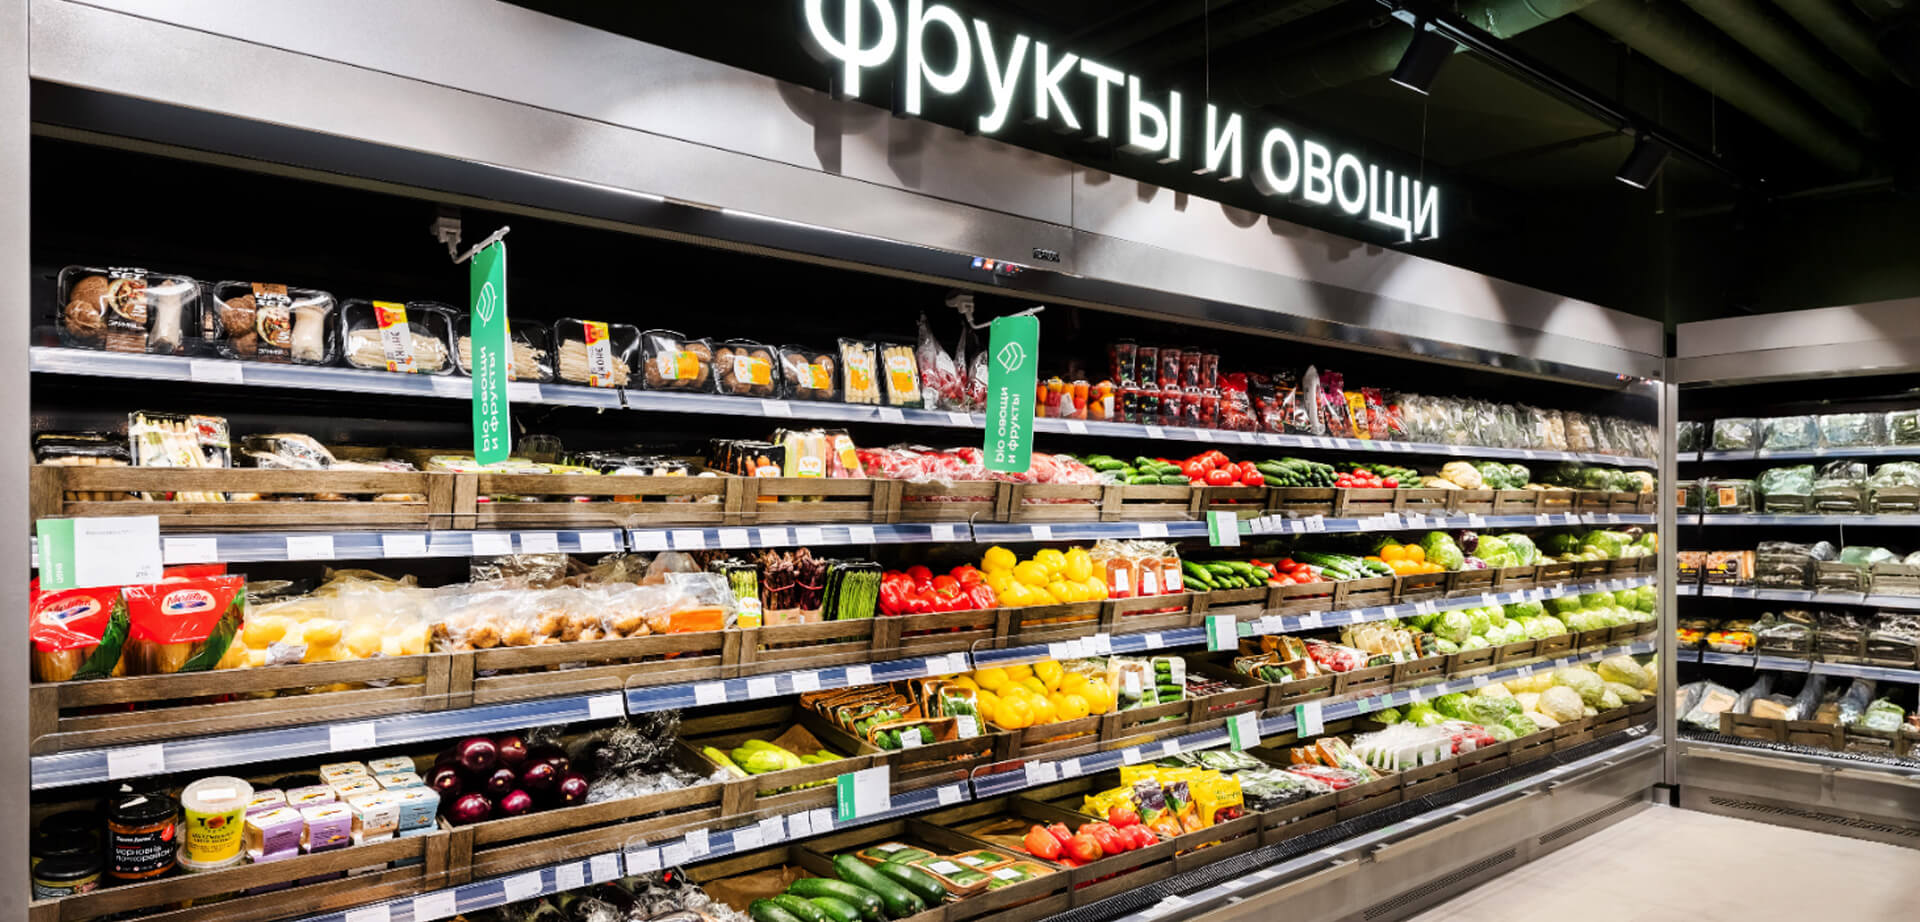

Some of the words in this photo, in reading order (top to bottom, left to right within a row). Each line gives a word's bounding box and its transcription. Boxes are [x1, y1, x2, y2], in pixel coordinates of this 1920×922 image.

[1205, 103, 1242, 178] и
[1260, 127, 1439, 242] овощи
[480, 346, 488, 415] овощи
[488, 352, 499, 433] фрукты
[482, 419, 490, 453] bio
[998, 387, 1009, 437] овощи
[1007, 393, 1021, 452] фрукты
[492, 439, 499, 450] и
[995, 439, 1005, 463] bio
[1008, 455, 1016, 464] и
